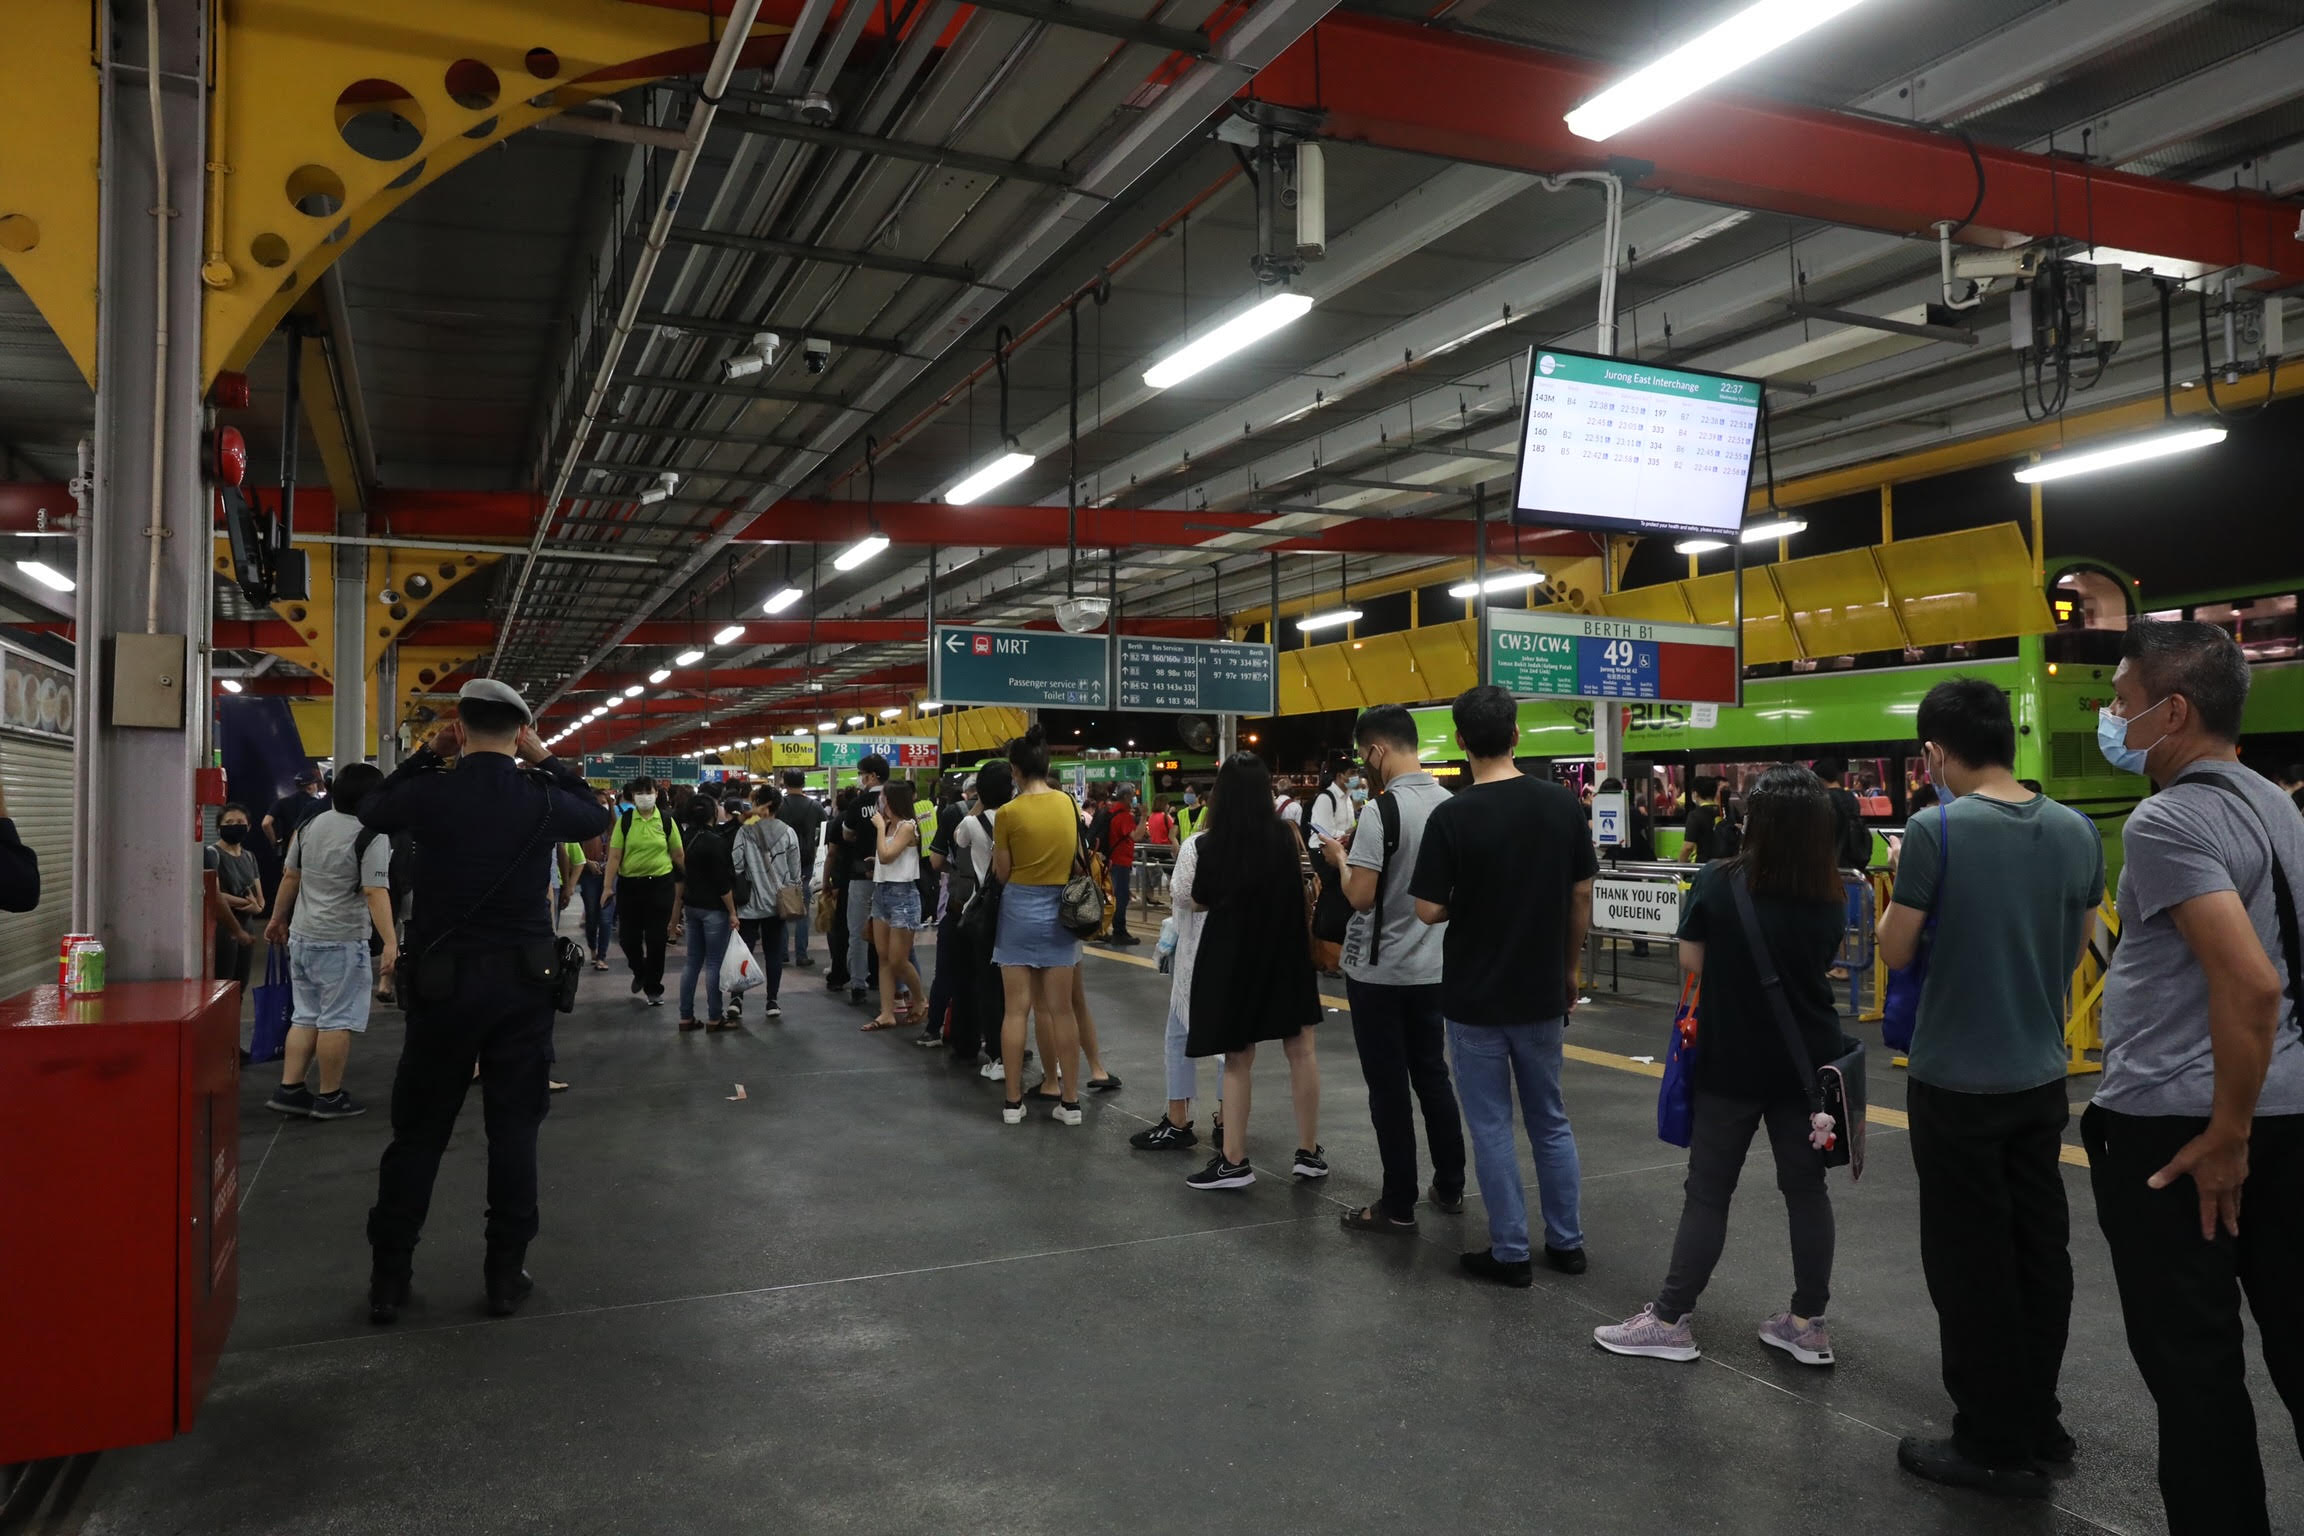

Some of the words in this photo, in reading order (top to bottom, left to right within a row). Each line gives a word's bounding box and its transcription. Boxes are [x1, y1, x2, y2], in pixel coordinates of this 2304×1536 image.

[1604, 369, 1633, 384] Jurong
[1633, 373, 1651, 385] East
[1652, 375, 1700, 393] Interchange
[1720, 382, 1744, 394] 22:37
[1535, 393, 1555, 402] 143M
[1533, 410, 1553, 419] 160M
[1654, 409, 1667, 417] 197
[1534, 427, 1547, 436] 160
[1652, 425, 1665, 434] 333
[1532, 444, 1546, 453] 183
[1649, 441, 1662, 450] 334
[1647, 457, 1660, 466] 335
[1584, 621, 1631, 638] BERTH
[1639, 625, 1653, 639] B1
[996, 638, 1030, 655] MRT
[1498, 633, 1571, 654] CW3/CW4
[1140, 653, 1150, 661] 78
[1183, 655, 1196, 664] 335
[1603, 640, 1633, 667] 49
[1198, 657, 1207, 665] 41
[1228, 658, 1238, 666] 79
[1155, 668, 1165, 676] 98
[1184, 670, 1196, 678] 105
[1213, 671, 1222, 679] 97
[1241, 672, 1252, 680] 197
[1008, 677, 1047, 689] Passenger
[1048, 680, 1077, 689] service
[1140, 682, 1149, 690] 52
[1152, 682, 1165, 690] 143
[1183, 684, 1196, 692] 333
[1043, 691, 1066, 701] Toilet
[1168, 697, 1180, 705] 183
[1183, 697, 1196, 706] 506
[1629, 702, 1684, 731] BUS
[833, 743, 848, 754] 78
[869, 744, 891, 755] 160
[908, 744, 929, 756] 335
[1166, 761, 1178, 769] 335
[705, 769, 715, 777] 98
[1595, 886, 1629, 901] THANK
[1631, 889, 1653, 903] YOU
[1656, 890, 1677, 905] FOR
[1608, 904, 1661, 921] QUEUEING
